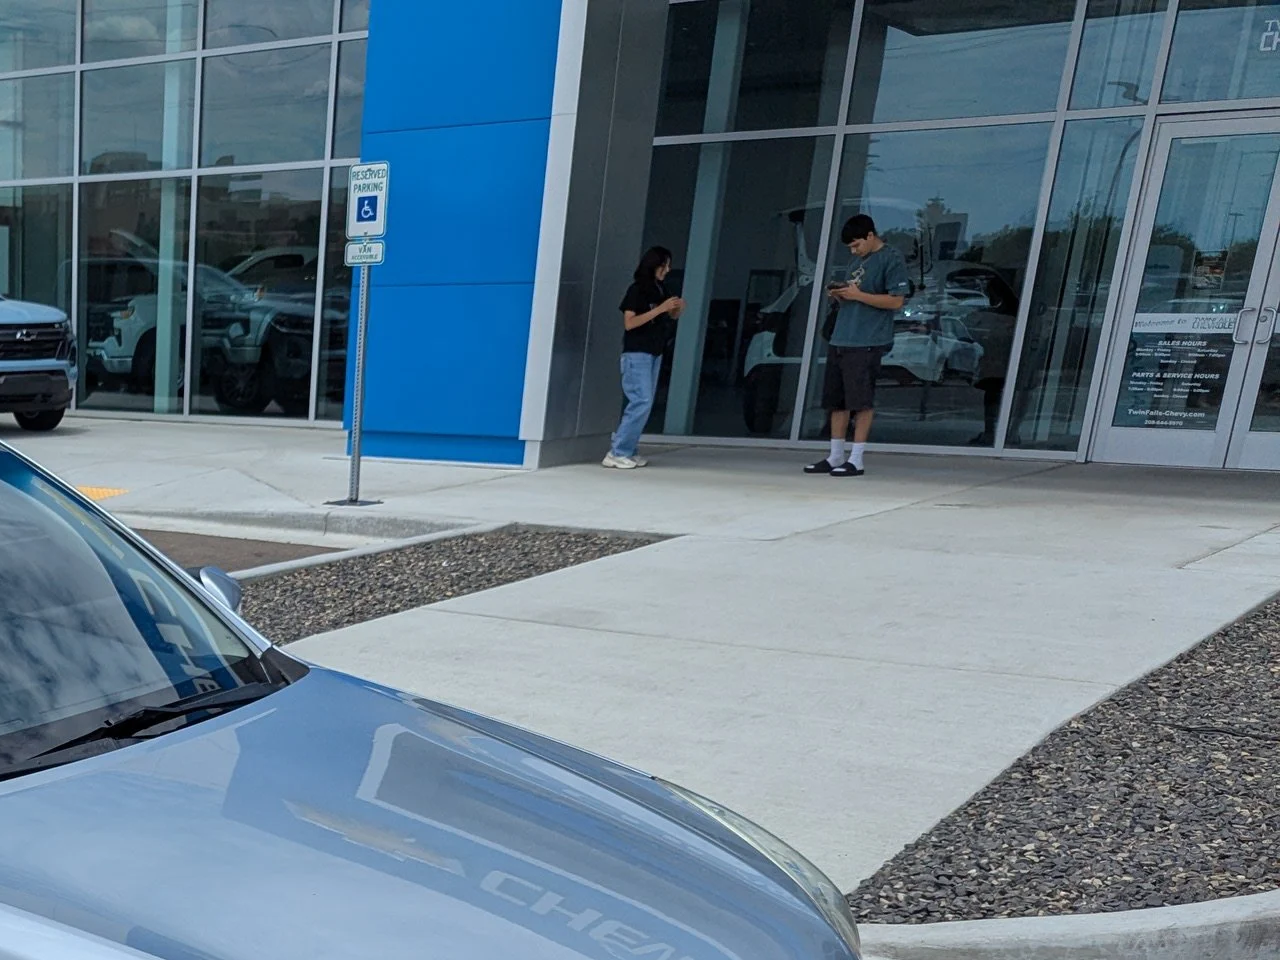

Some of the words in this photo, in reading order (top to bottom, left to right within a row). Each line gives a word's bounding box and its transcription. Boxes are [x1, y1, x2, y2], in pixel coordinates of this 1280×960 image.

[352, 169, 386, 181] RESERVED
[353, 182, 383, 193] PARKING
[358, 246, 372, 254] VAN
[1127, 408, 1206, 418] TwinFalls-Chevy.com
